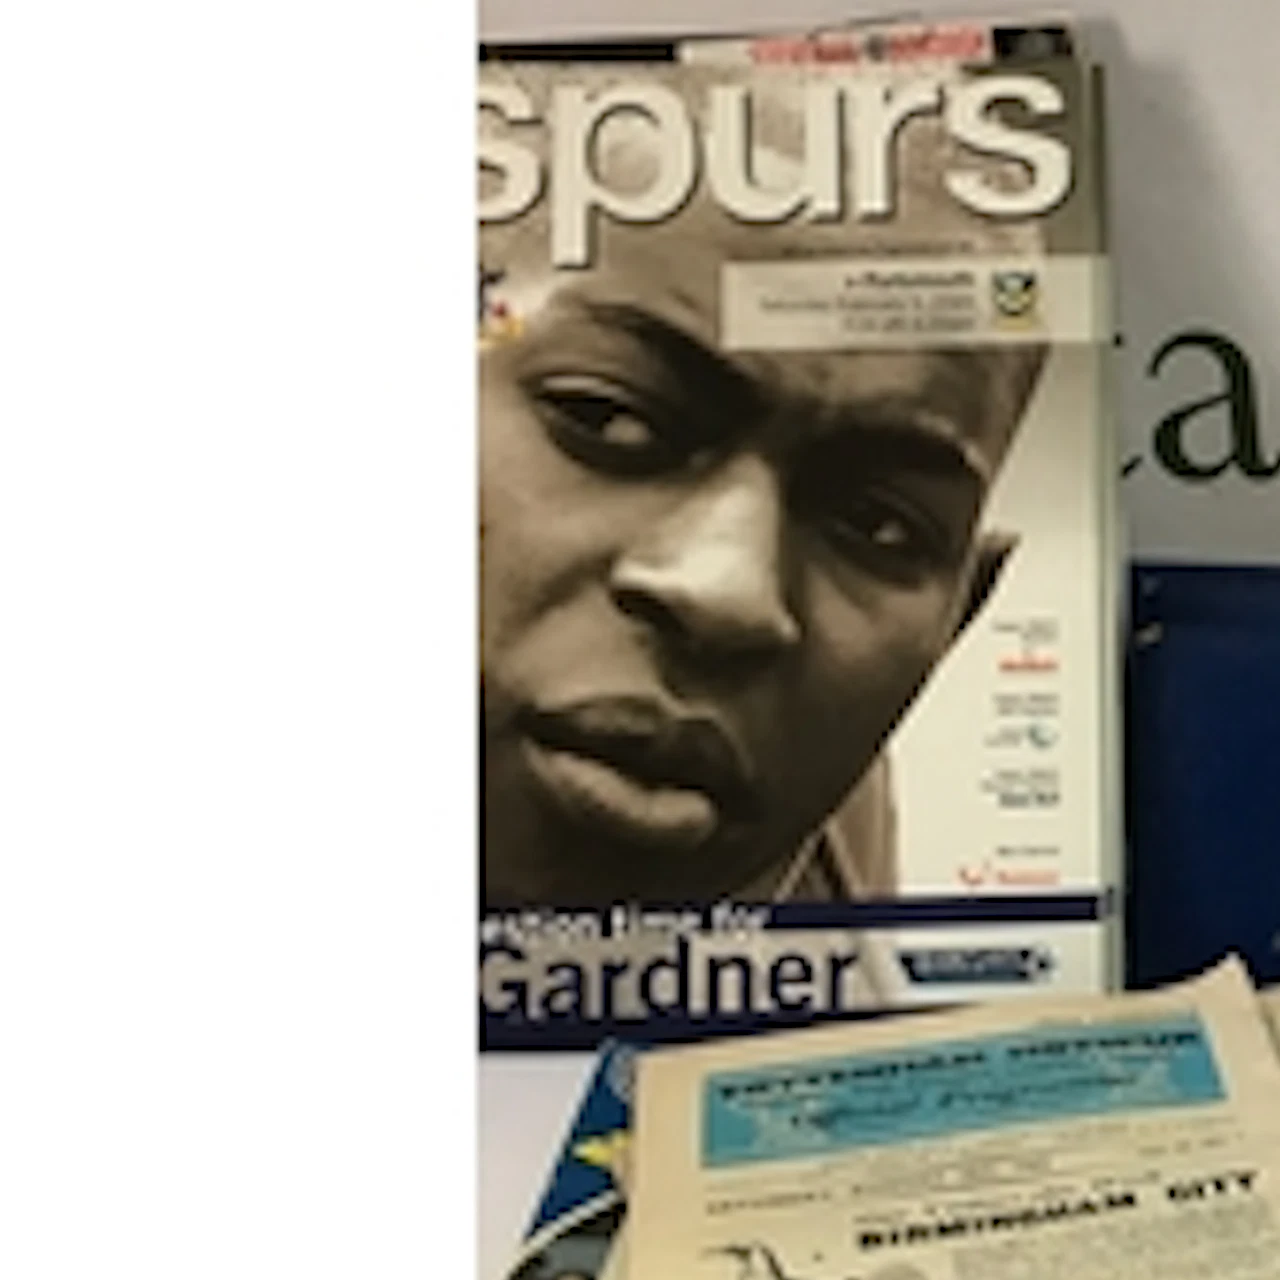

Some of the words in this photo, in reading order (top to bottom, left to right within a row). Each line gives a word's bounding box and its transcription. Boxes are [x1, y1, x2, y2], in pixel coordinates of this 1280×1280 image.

[478, 73, 1078, 271] spurs
[480, 936, 860, 1020] Gardner
[857, 1190, 1139, 1253] BIRMINGHAM
[1165, 1169, 1260, 1206] CITY
